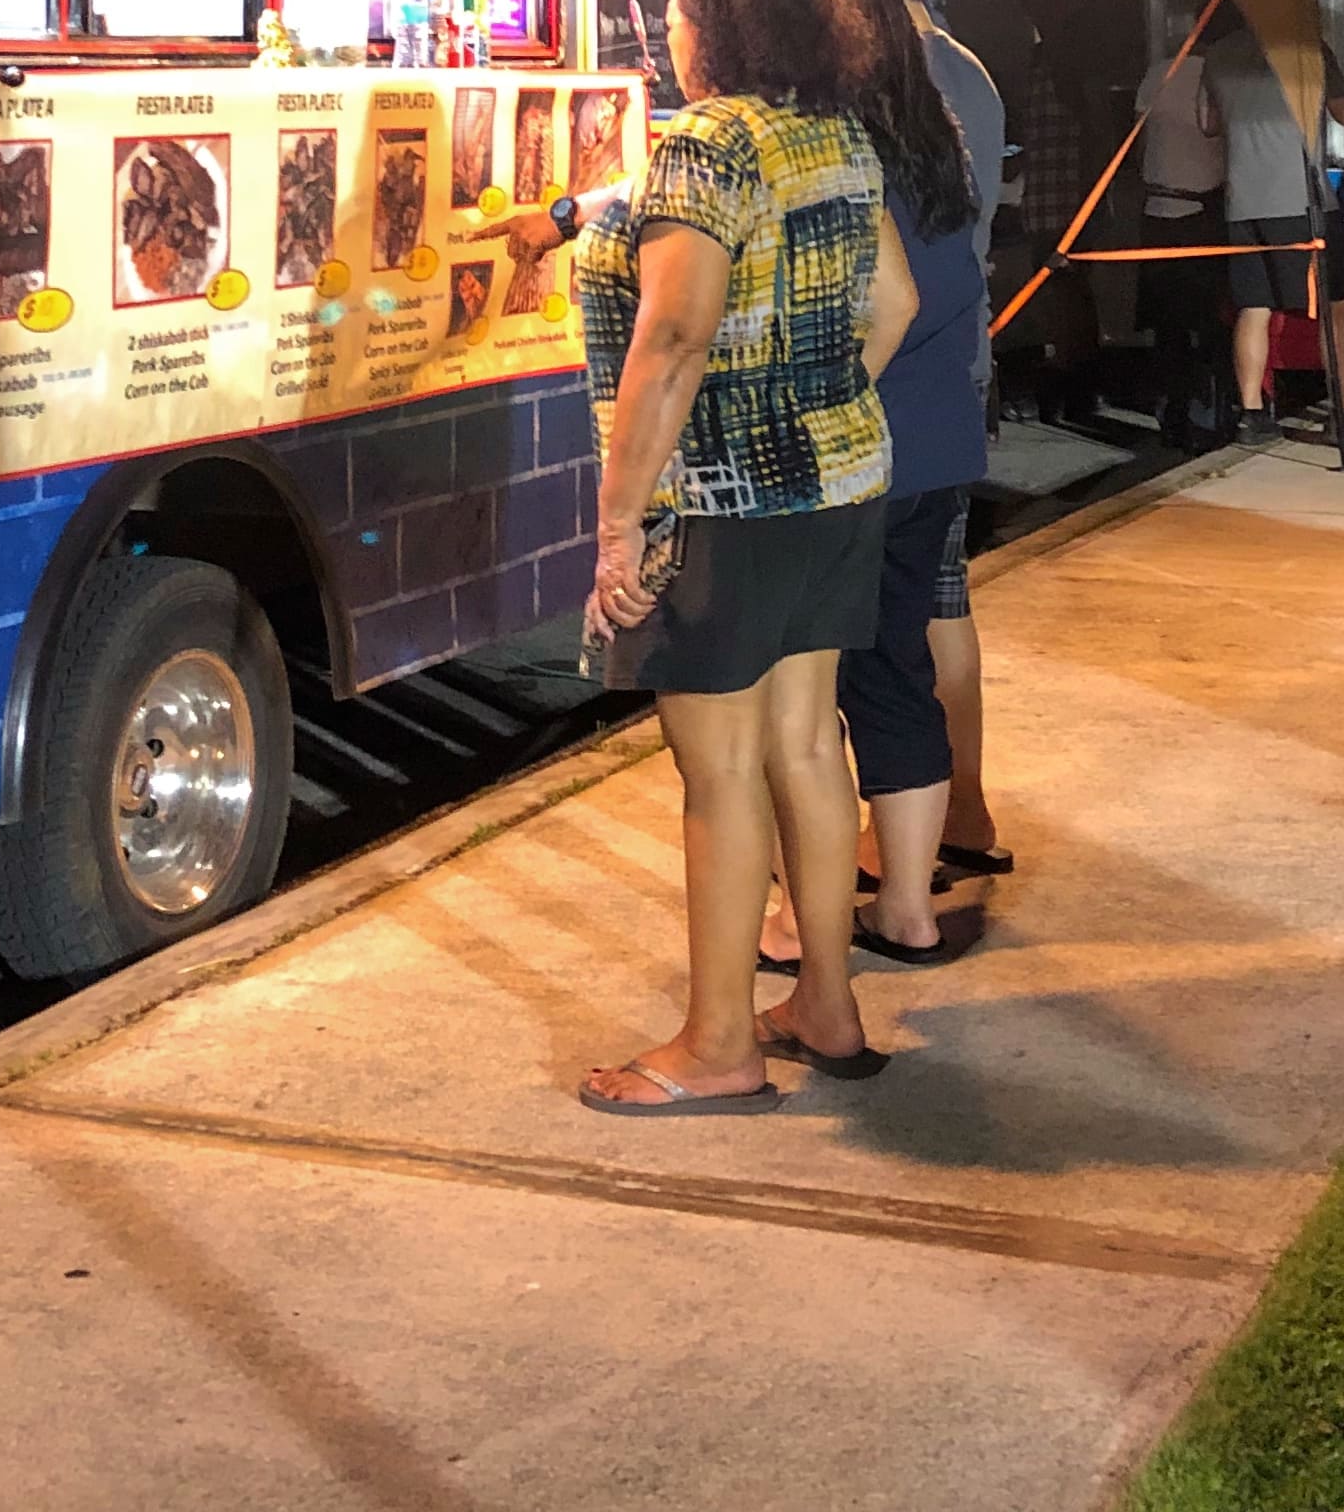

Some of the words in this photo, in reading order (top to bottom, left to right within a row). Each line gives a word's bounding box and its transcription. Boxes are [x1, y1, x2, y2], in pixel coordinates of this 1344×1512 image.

[7, 98, 44, 119] PLATE
[45, 98, 55, 117] A
[136, 96, 172, 115] FIESTA
[174, 96, 205, 114] PLATE
[277, 93, 307, 112] FIESTA
[309, 93, 336, 112] PLATE
[374, 92, 401, 110] FIESTA
[403, 92, 426, 110] PLATE
[132, 356, 157, 374] Pork
[124, 383, 149, 400] Corn
[151, 382, 166, 395] on
[168, 375, 188, 393] the
[189, 372, 209, 390] Cob
